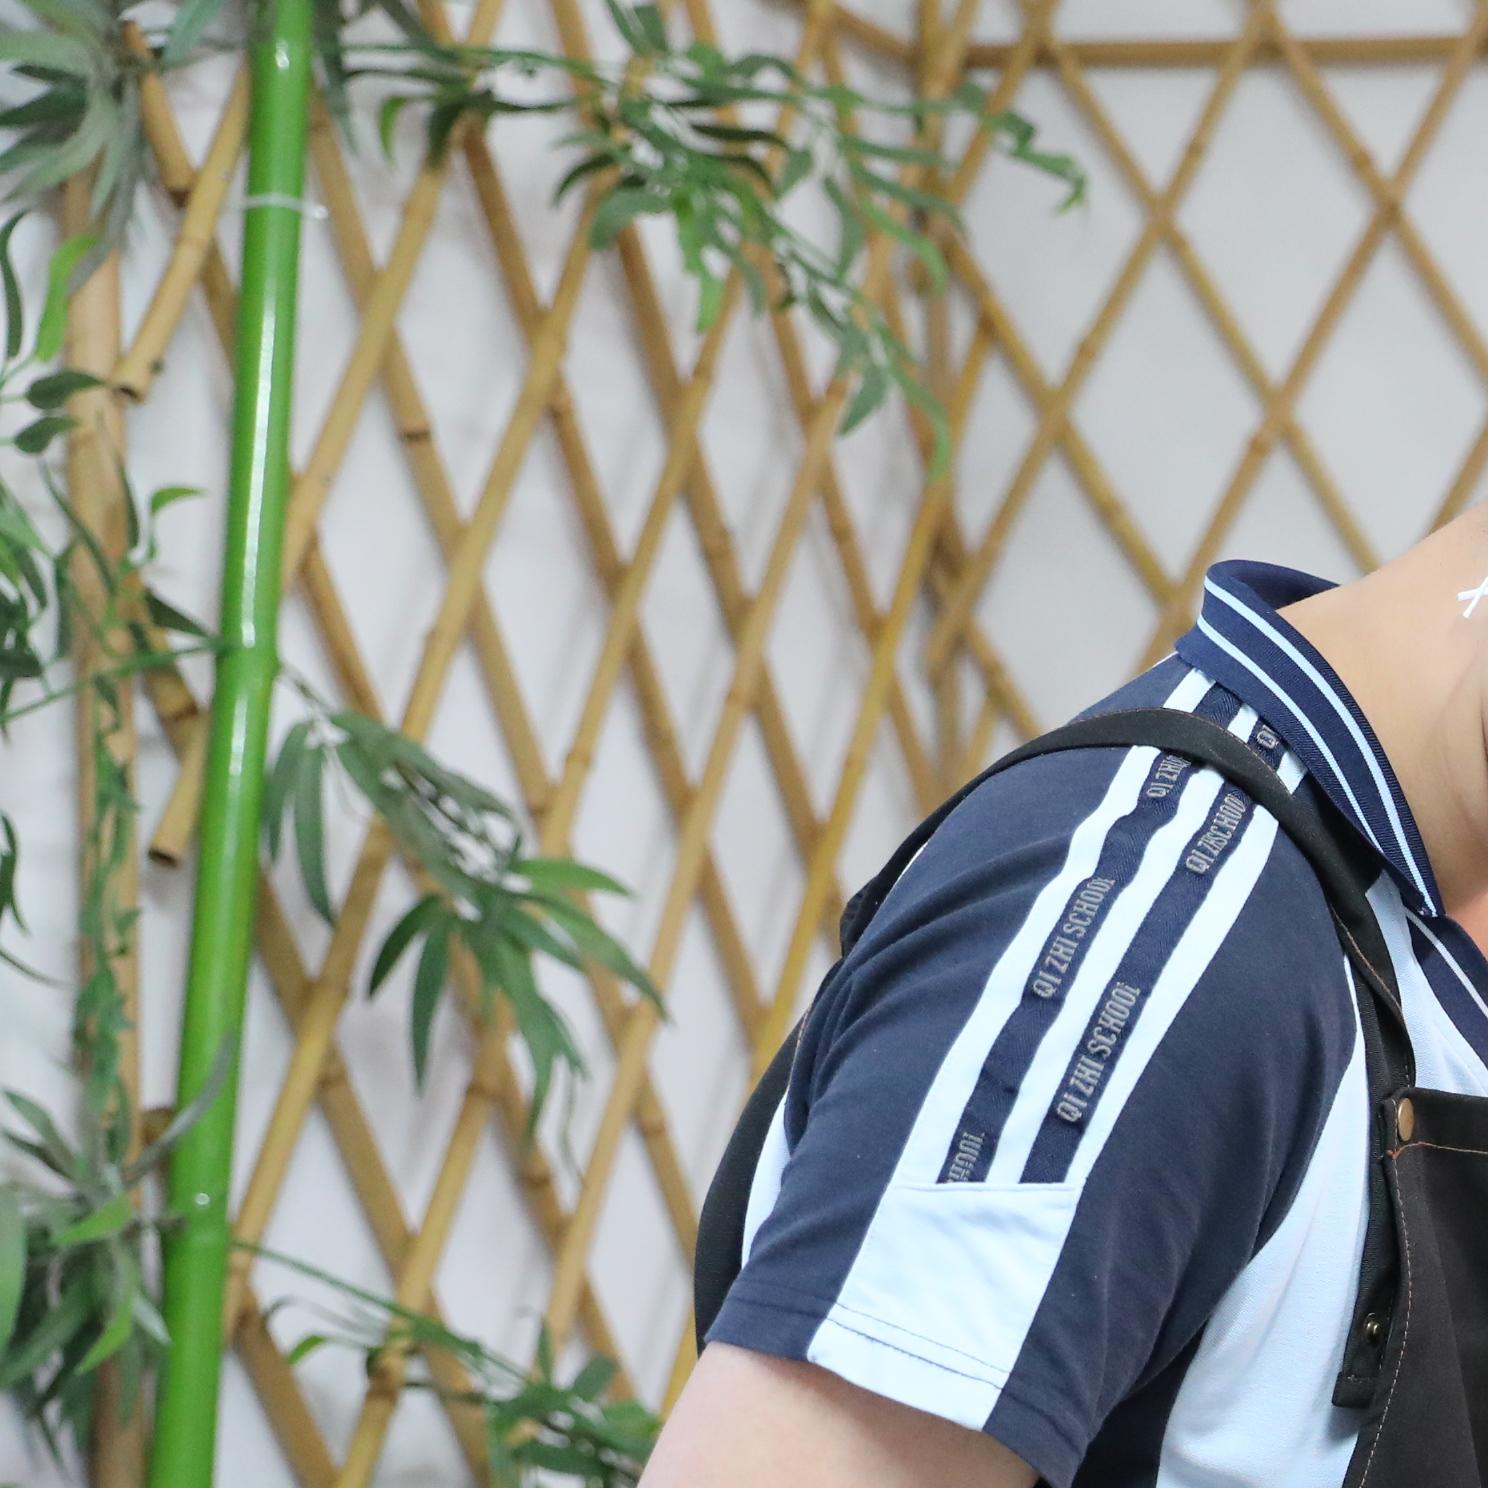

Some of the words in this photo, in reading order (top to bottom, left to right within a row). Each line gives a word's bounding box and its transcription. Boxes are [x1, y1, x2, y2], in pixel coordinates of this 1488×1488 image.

[1146, 782, 1174, 797] QI
[1185, 849, 1215, 874] QI
[1045, 935, 1079, 974] ZHI
[1033, 971, 1062, 998] QI
[1087, 982, 1141, 1061] SCHOOL
[1069, 1055, 1104, 1097] ZHI
[1056, 1092, 1088, 1122] QI
